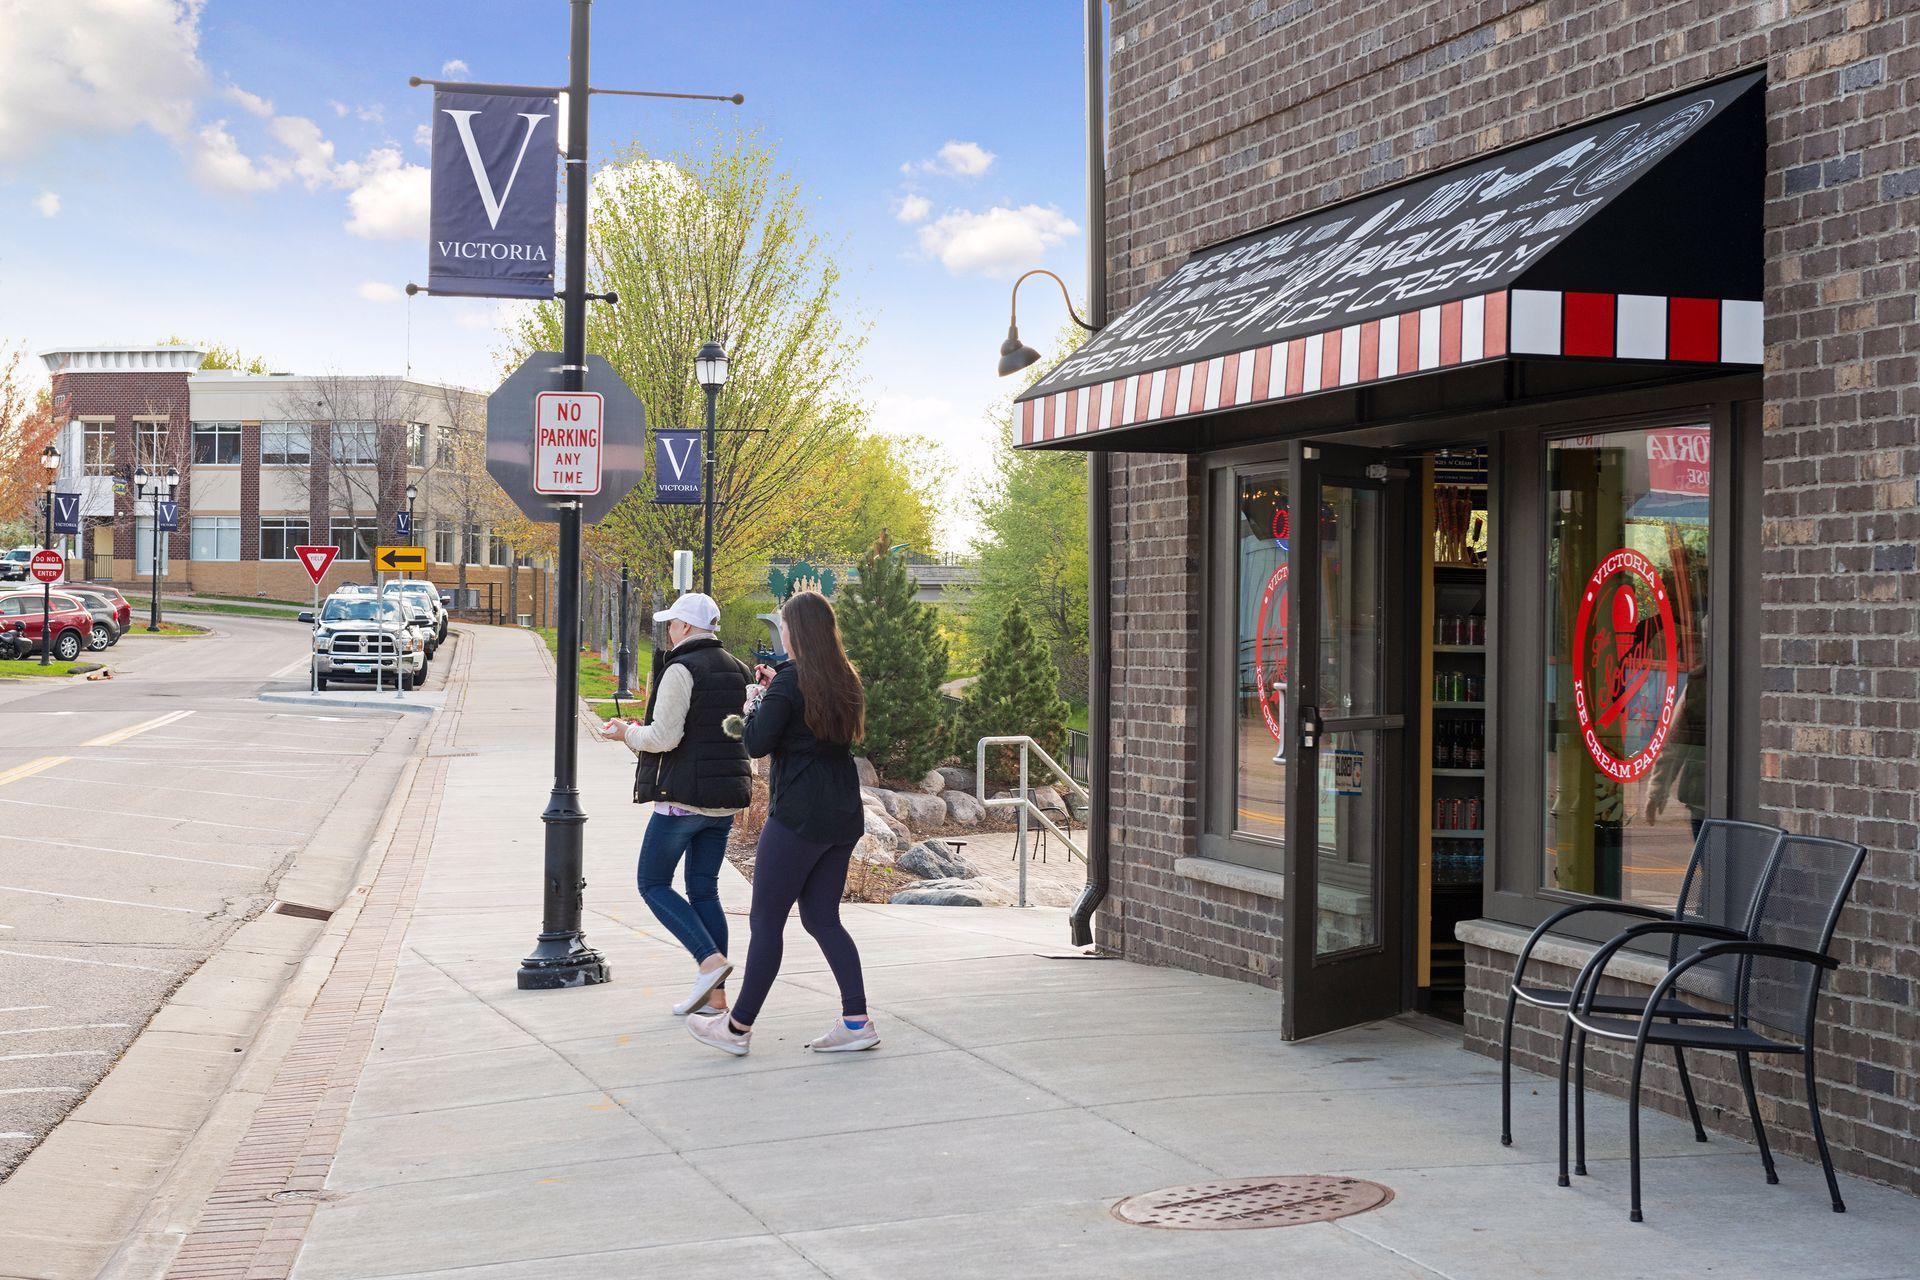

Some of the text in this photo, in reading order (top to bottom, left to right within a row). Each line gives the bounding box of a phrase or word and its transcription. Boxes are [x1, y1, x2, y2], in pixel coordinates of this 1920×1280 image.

[441, 109, 551, 231] V
[1543, 122, 1641, 193] 2
[1385, 166, 1506, 235] CONES
[1512, 194, 1560, 213] SCOOPS
[1519, 196, 1604, 238] SUNDAES
[438, 241, 548, 261] VICTORIA
[1158, 253, 1228, 291] THE
[1203, 226, 1312, 278] SOCIAL
[1317, 208, 1508, 288] PARLOR
[1262, 287, 1360, 333] ICE
[1344, 235, 1560, 313] CREAM
[1136, 286, 1271, 340] CONES
[1046, 323, 1218, 384] PREMIUM
[557, 403, 581, 421] NO
[541, 428, 597, 447] PARKING
[553, 471, 583, 484] TIME
[556, 453, 581, 465] ANY
[659, 438, 698, 481] V
[659, 484, 698, 492] VICTORIA
[57, 497, 77, 521] V
[161, 505, 177, 522] V
[398, 514, 409, 529] V
[1268, 566, 1289, 591] VICT
[1593, 553, 1655, 588] VICTORIA
[1256, 666, 1265, 702] ICE
[1263, 704, 1280, 739] CRE
[1575, 680, 1675, 779] ICE CREAM PARLOR
